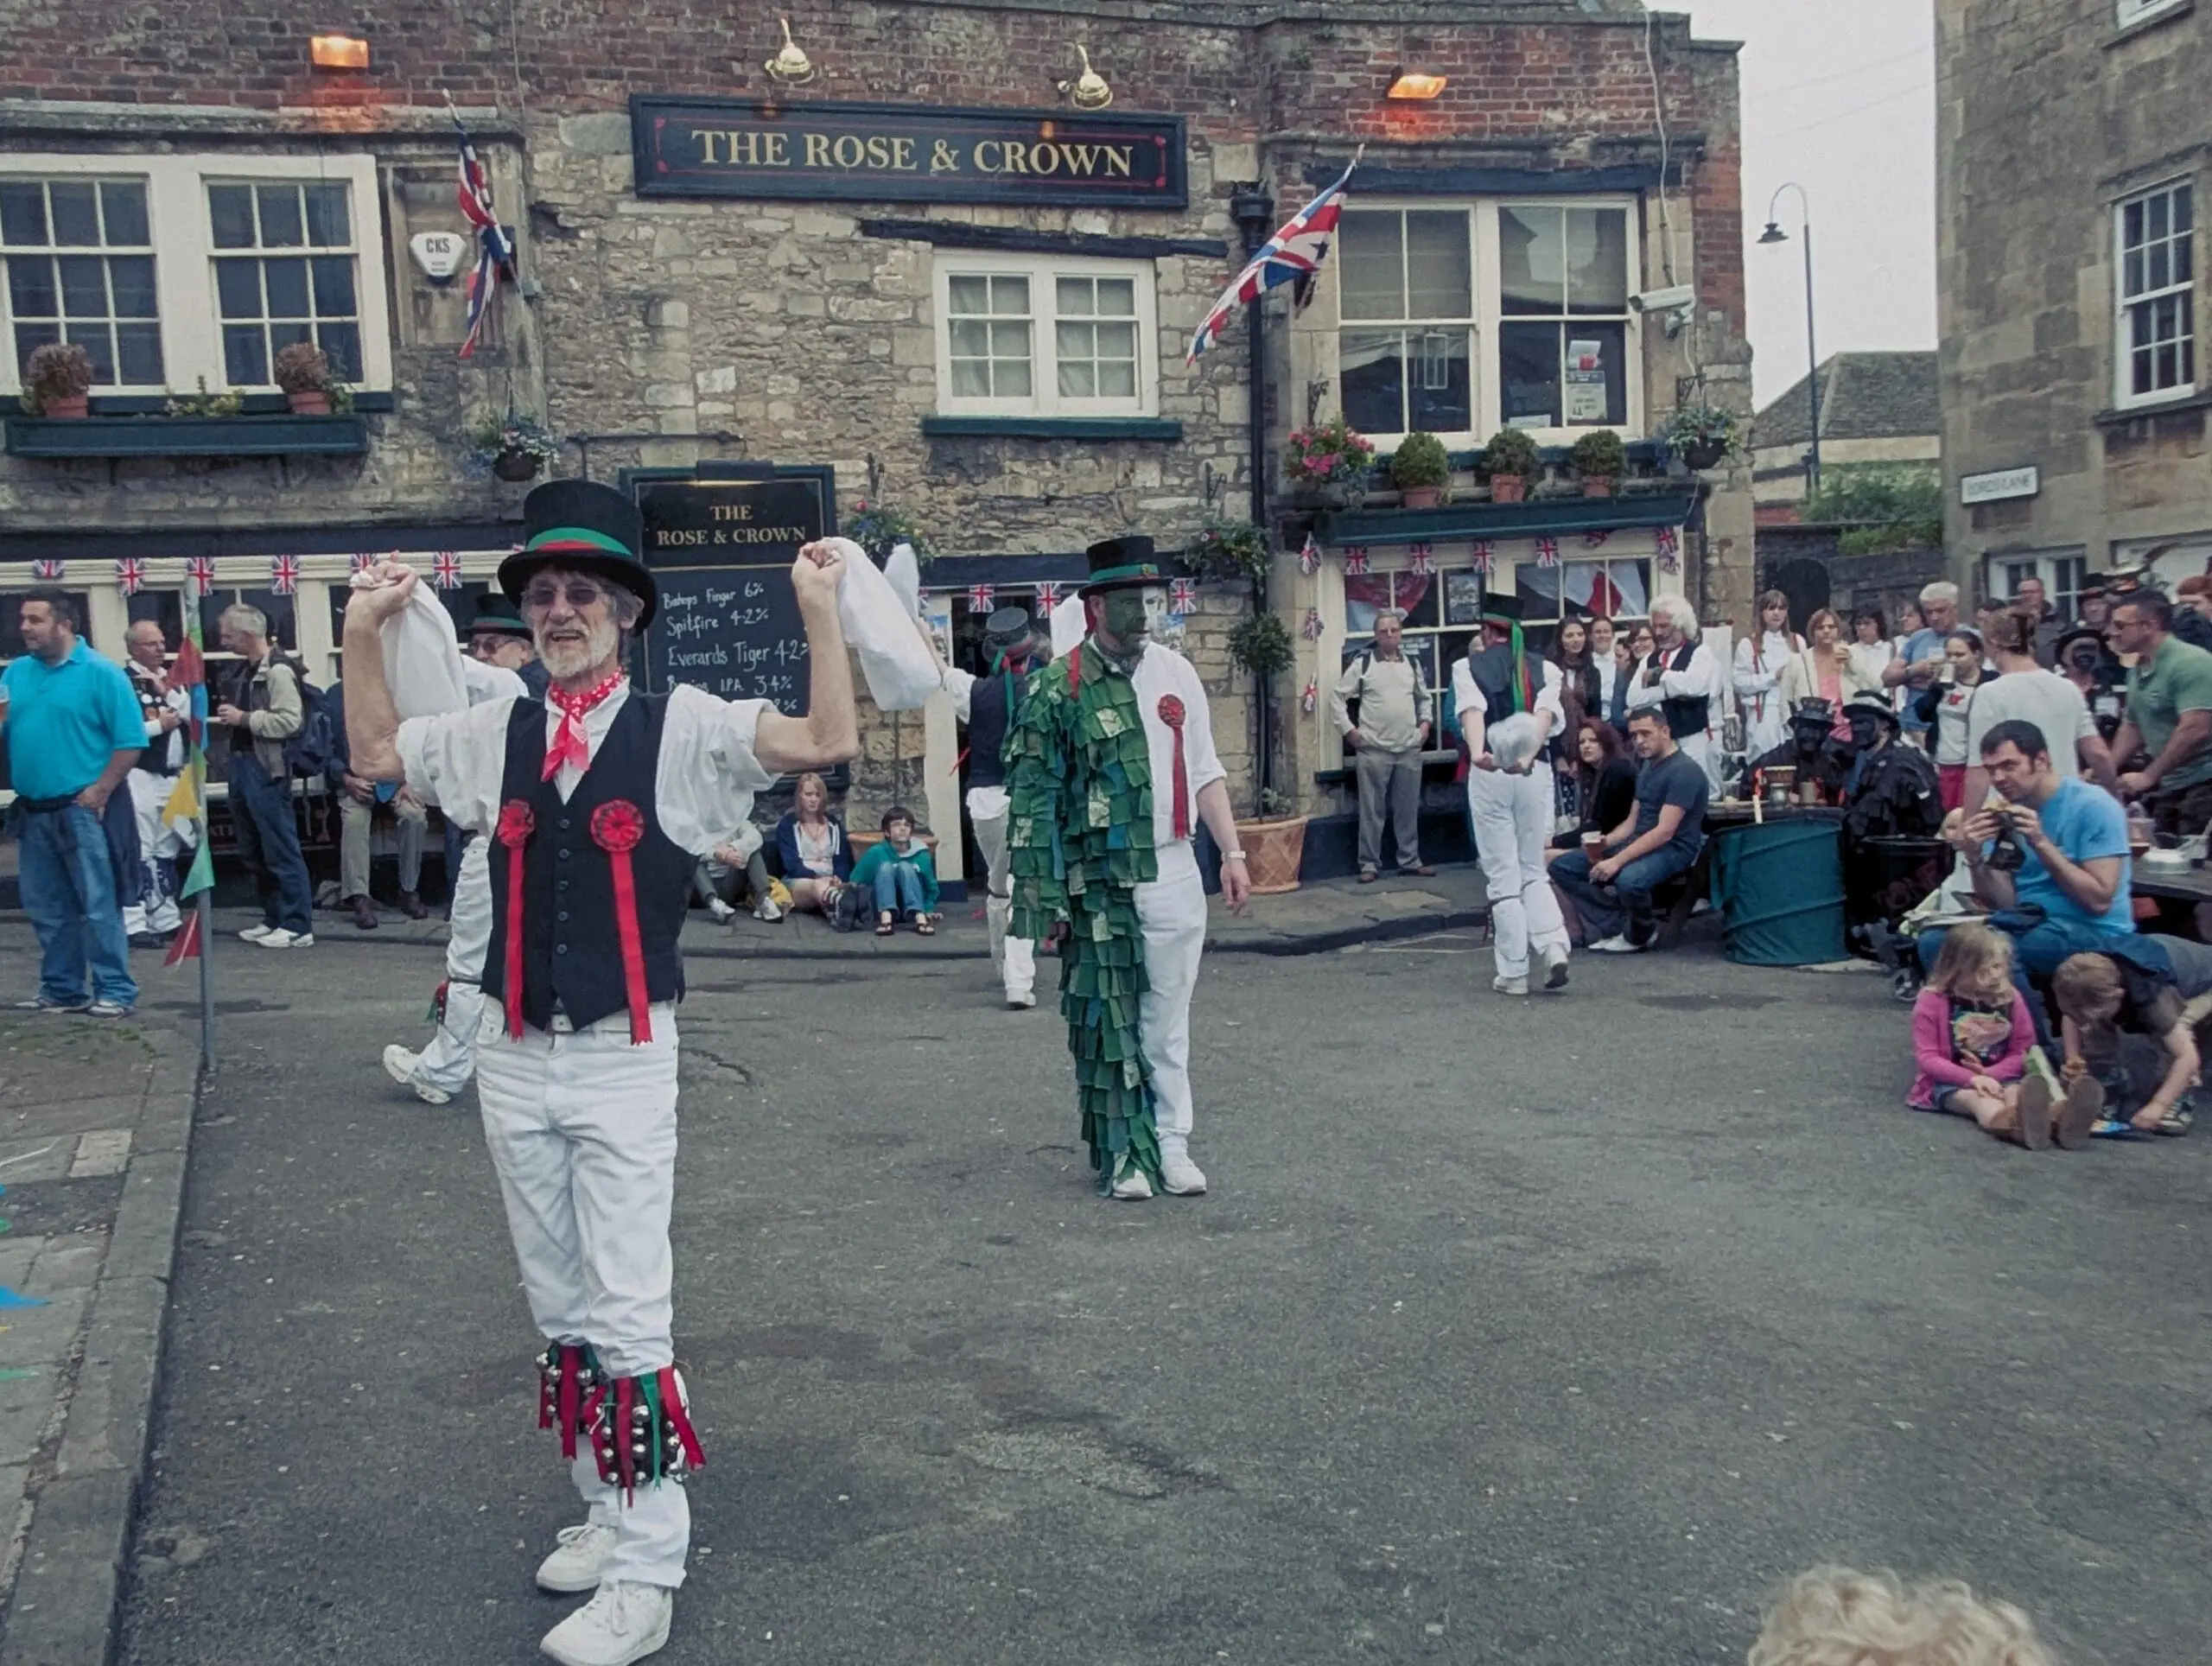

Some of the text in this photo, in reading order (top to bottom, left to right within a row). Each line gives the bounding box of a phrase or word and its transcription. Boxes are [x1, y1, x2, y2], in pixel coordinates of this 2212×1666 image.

[691, 130, 1134, 176] THE ROSE & CROWN
[426, 238, 450, 253] CKS
[709, 505, 753, 520] THE
[657, 526, 806, 546] ROSE & CROWN
[744, 582, 764, 597] 6%
[666, 613, 719, 639] Spitfire
[667, 643, 728, 666] Everards
[733, 640, 771, 672] Tiger
